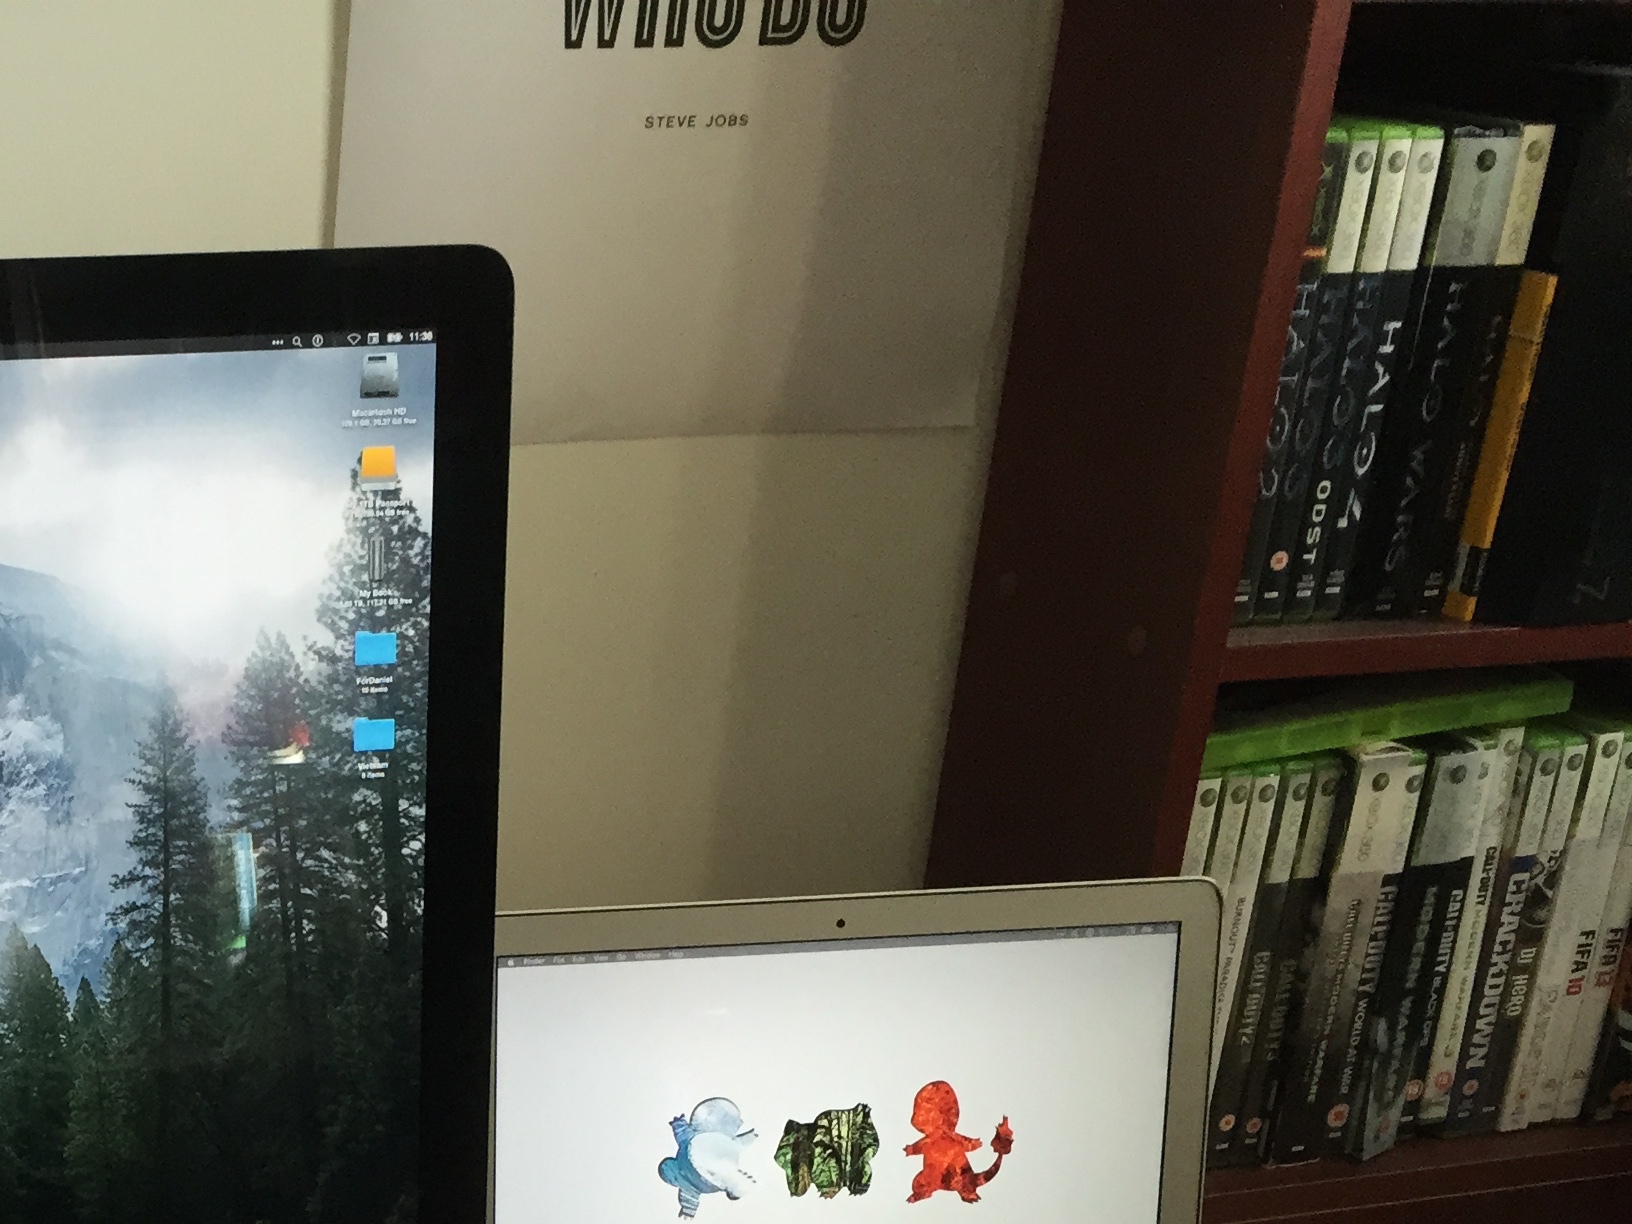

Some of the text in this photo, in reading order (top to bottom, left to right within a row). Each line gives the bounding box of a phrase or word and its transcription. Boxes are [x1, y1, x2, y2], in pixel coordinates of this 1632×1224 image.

[644, 113, 749, 129] STEVE JOBS
[1421, 280, 1466, 425] HALO
[1353, 319, 1404, 479] HALO
[1302, 479, 1333, 566] ODST
[1465, 872, 1531, 1070] CRACKDOWN
[1516, 947, 1538, 966] DJ
[1566, 929, 1597, 996] FIFA 10
[1600, 926, 1625, 968] FIFA
[1349, 997, 1369, 1046] WORLD
